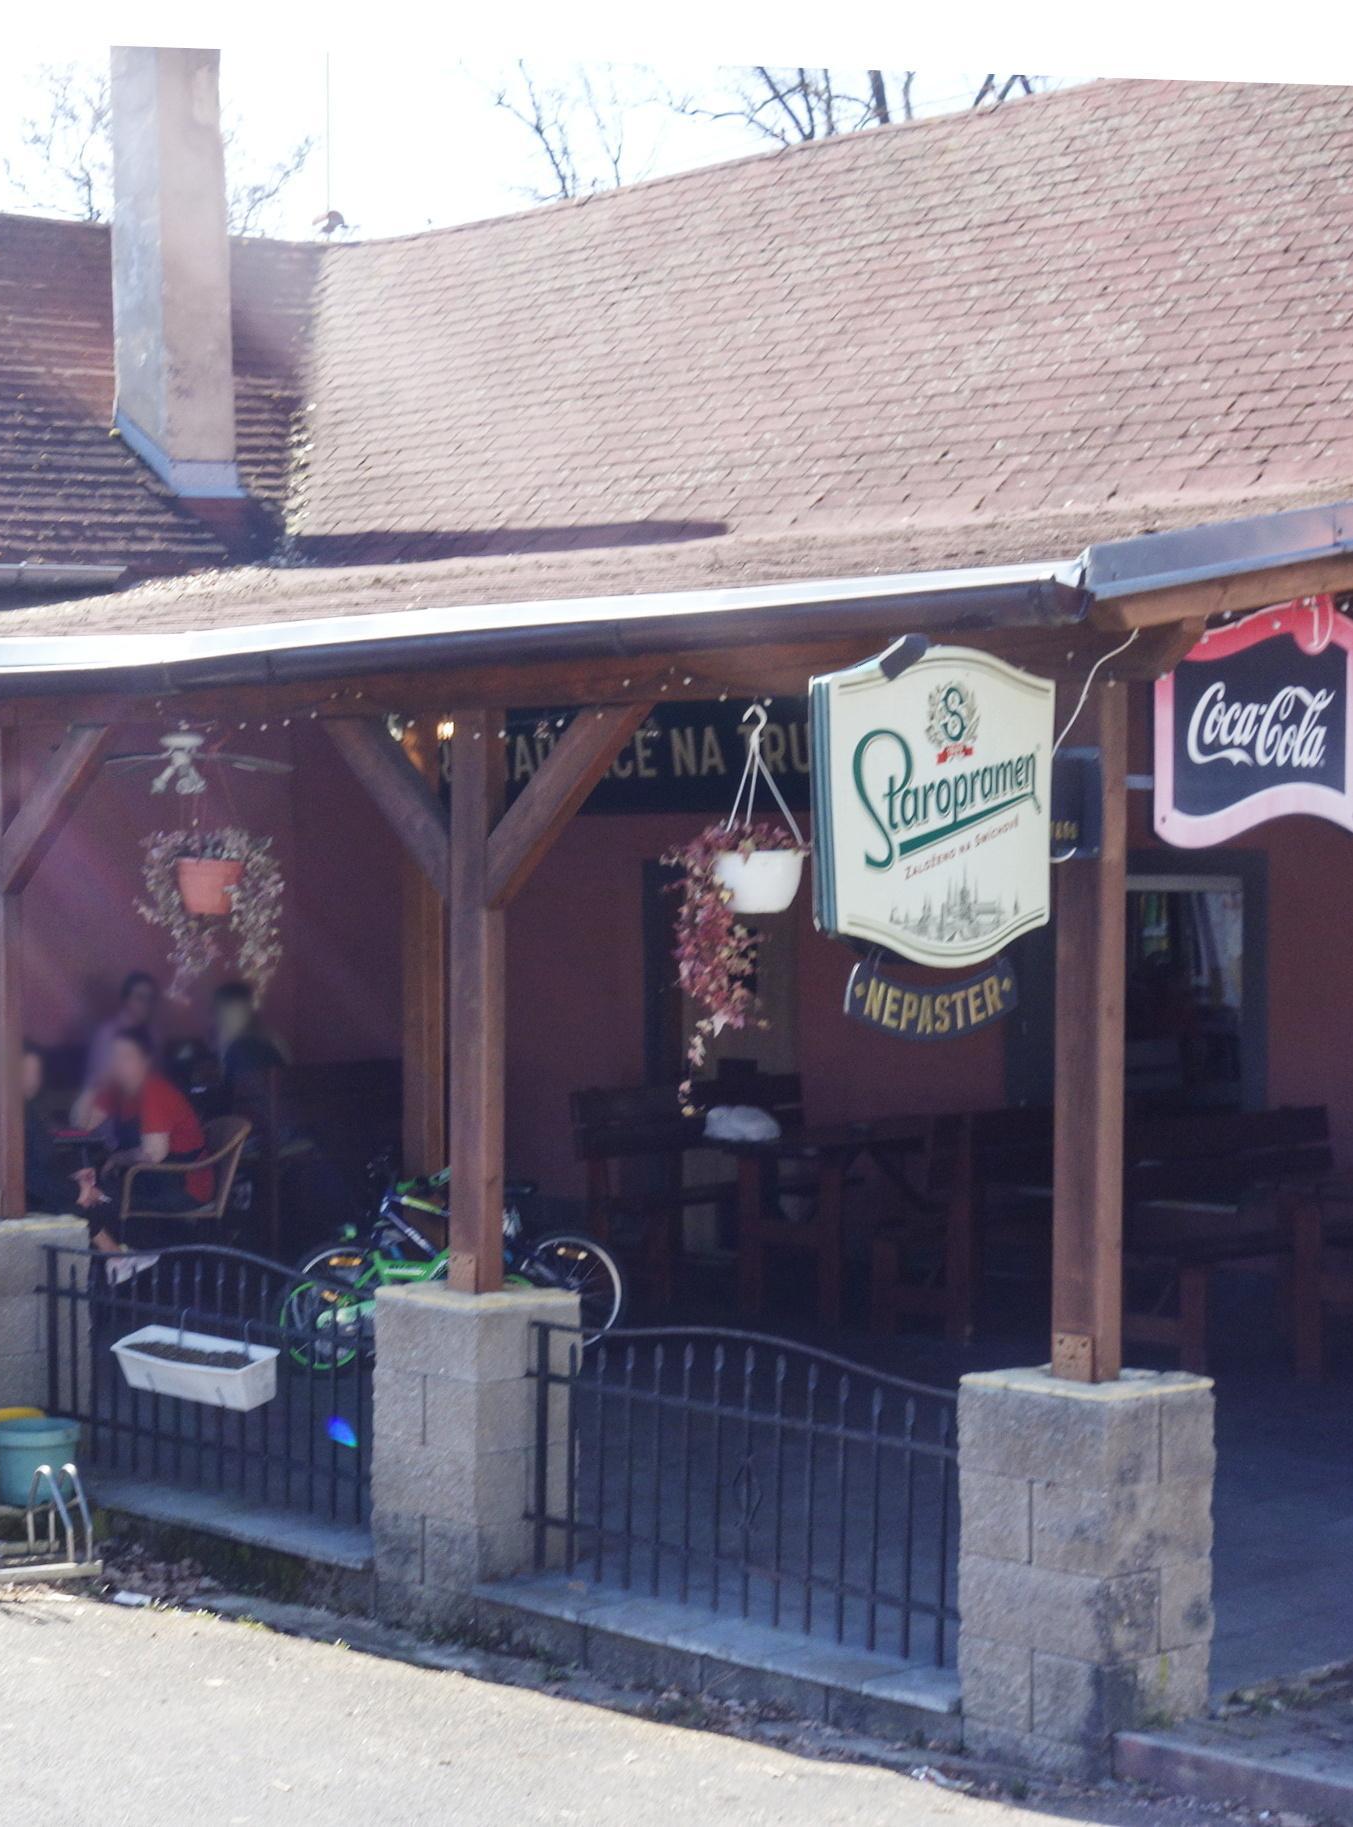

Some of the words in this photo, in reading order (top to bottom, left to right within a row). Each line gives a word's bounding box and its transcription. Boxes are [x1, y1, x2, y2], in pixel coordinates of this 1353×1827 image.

[671, 725, 726, 777] NA
[1187, 681, 1335, 767] Coca-Cola
[853, 728, 1041, 870] Staropramen
[863, 975, 1004, 1035] NEPASTER
